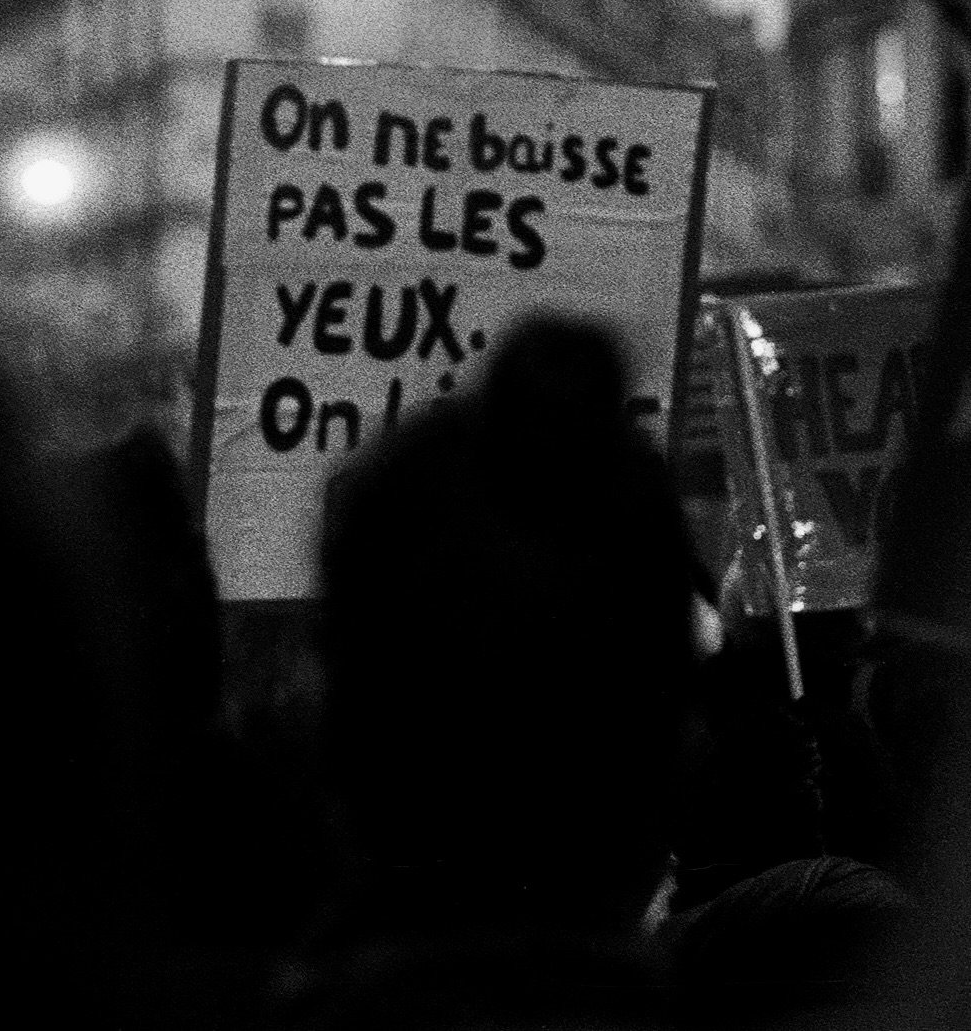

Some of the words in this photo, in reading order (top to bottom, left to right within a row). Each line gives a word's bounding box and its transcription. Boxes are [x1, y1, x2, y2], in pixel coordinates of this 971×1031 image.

[260, 83, 349, 151] On
[267, 181, 396, 249] PAS
[418, 186, 546, 271] LES
[276, 278, 487, 364] YEUX.
[260, 376, 360, 453] On
